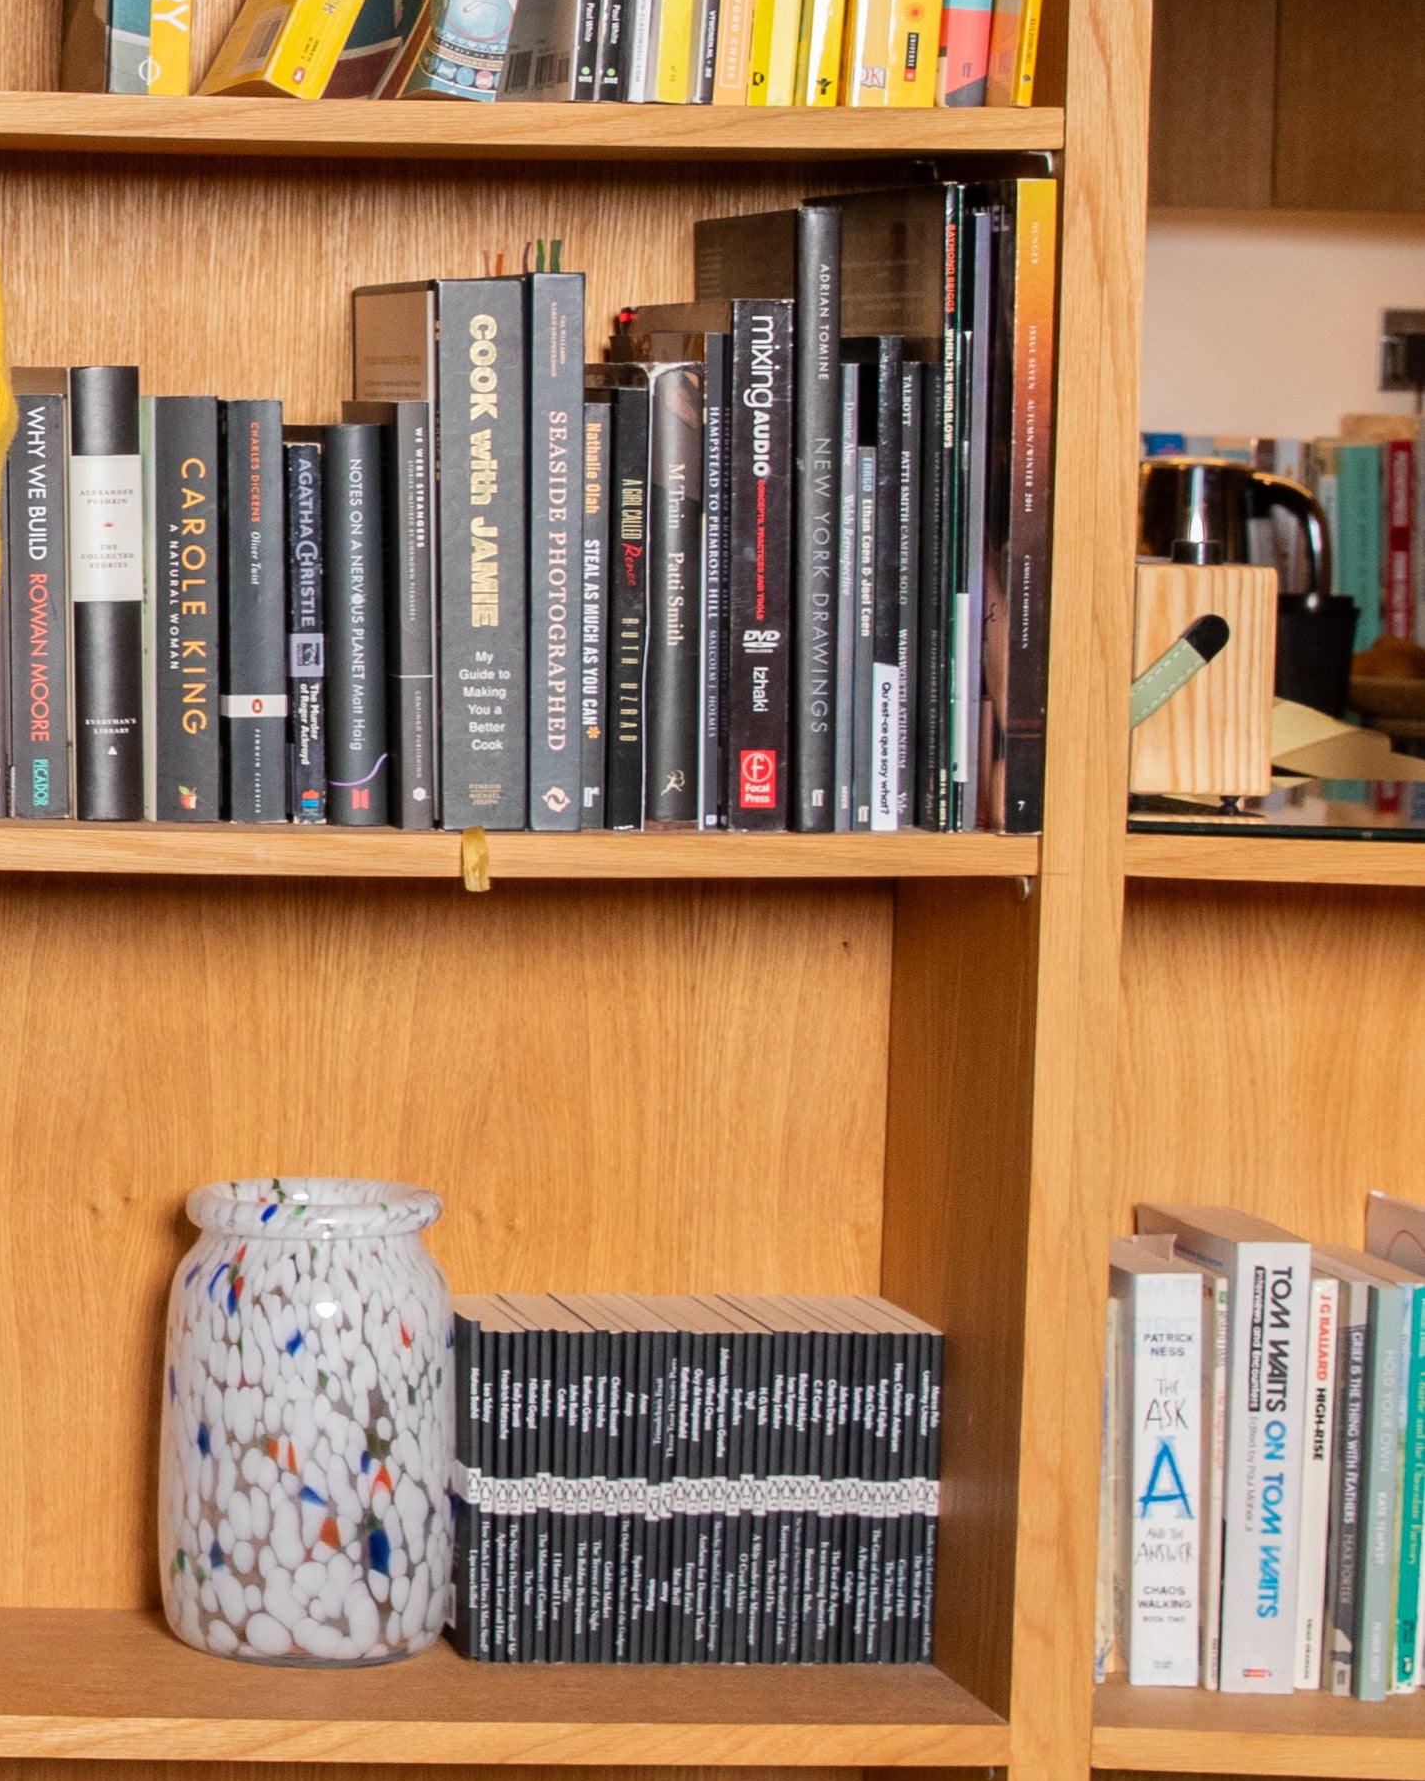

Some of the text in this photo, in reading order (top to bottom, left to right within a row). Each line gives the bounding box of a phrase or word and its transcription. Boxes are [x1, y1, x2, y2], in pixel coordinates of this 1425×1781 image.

[27, 406, 49, 742] WHY WE BUILD ROWAN MOORE
[169, 524, 179, 670] A NATURAL WOMAN
[181, 458, 207, 734] CAROLE KING
[470, 314, 497, 627] COOK with JAMIE
[548, 411, 567, 751] SEASIDE PHOTOGRAPHED
[667, 464, 684, 647] M Train Patti Smith
[747, 316, 777, 712] mixing AUDIO Izhaki
[811, 438, 831, 733] NEW YORK DRAWINGS
[298, 684, 309, 765] of Roger Ackroyd
[309, 684, 319, 740] The Murder
[1257, 1266, 1293, 1618] TOM WAITS ON TOM WAITS
